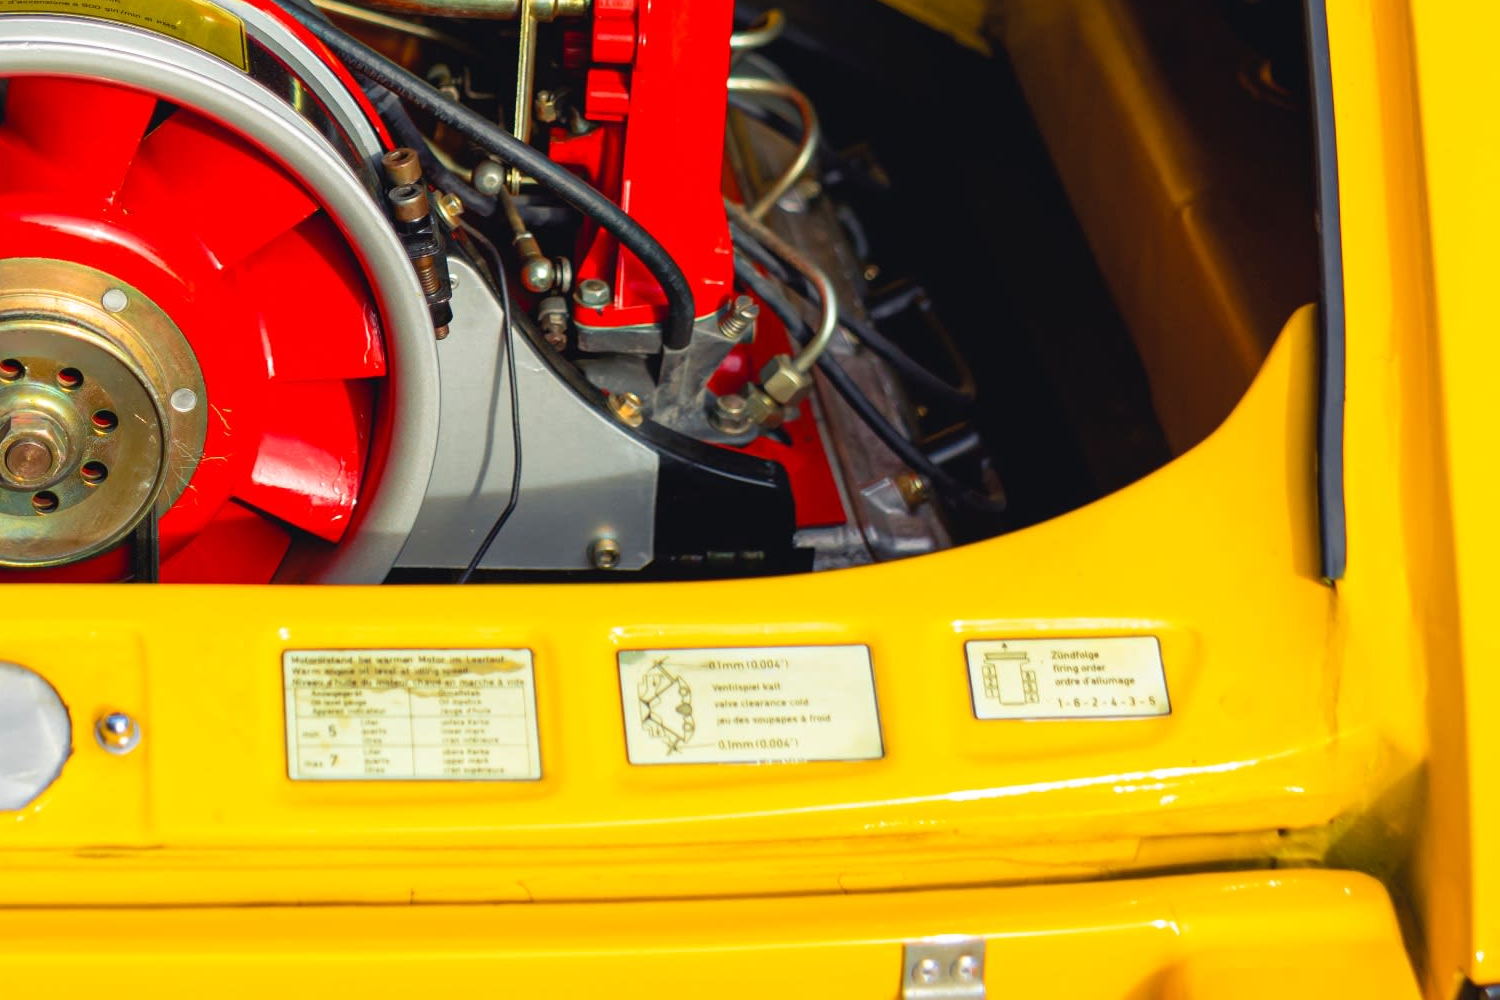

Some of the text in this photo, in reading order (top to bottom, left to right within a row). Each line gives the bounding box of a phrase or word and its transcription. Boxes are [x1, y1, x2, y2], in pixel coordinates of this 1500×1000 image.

[1053, 663, 1106, 674] firing order
[1055, 676, 1080, 686] ordre
[714, 699, 738, 708] valve
[740, 698, 786, 707] clearance
[327, 723, 337, 738] 5
[329, 753, 338, 767] 7
